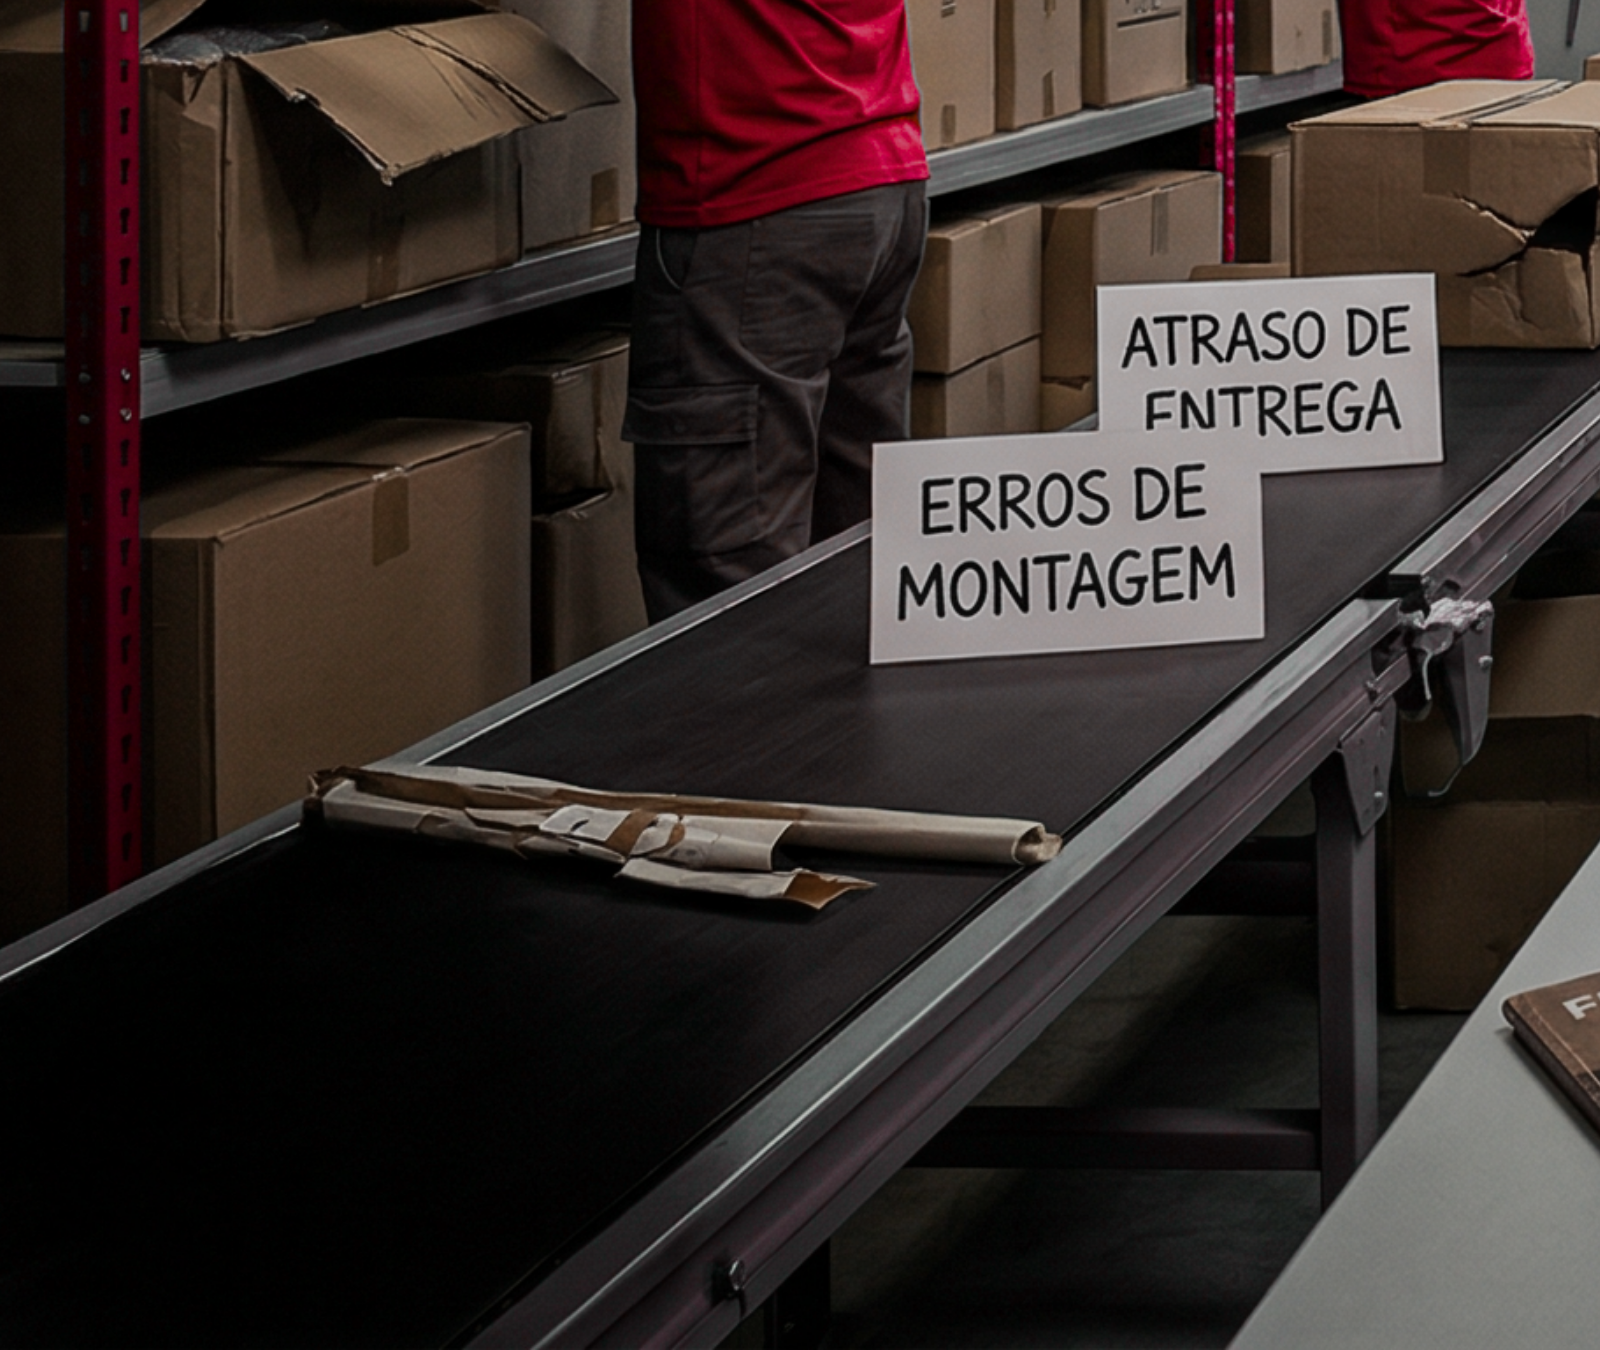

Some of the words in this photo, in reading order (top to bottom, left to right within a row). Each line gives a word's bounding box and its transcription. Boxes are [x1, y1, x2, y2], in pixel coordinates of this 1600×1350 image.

[1120, 308, 1326, 369] ATRASO
[1345, 304, 1412, 357] DE
[1145, 378, 1403, 437] ENTREGA
[920, 468, 1111, 536] ERROS
[1133, 463, 1207, 521] DE
[897, 542, 1236, 621] MONTAGEM
